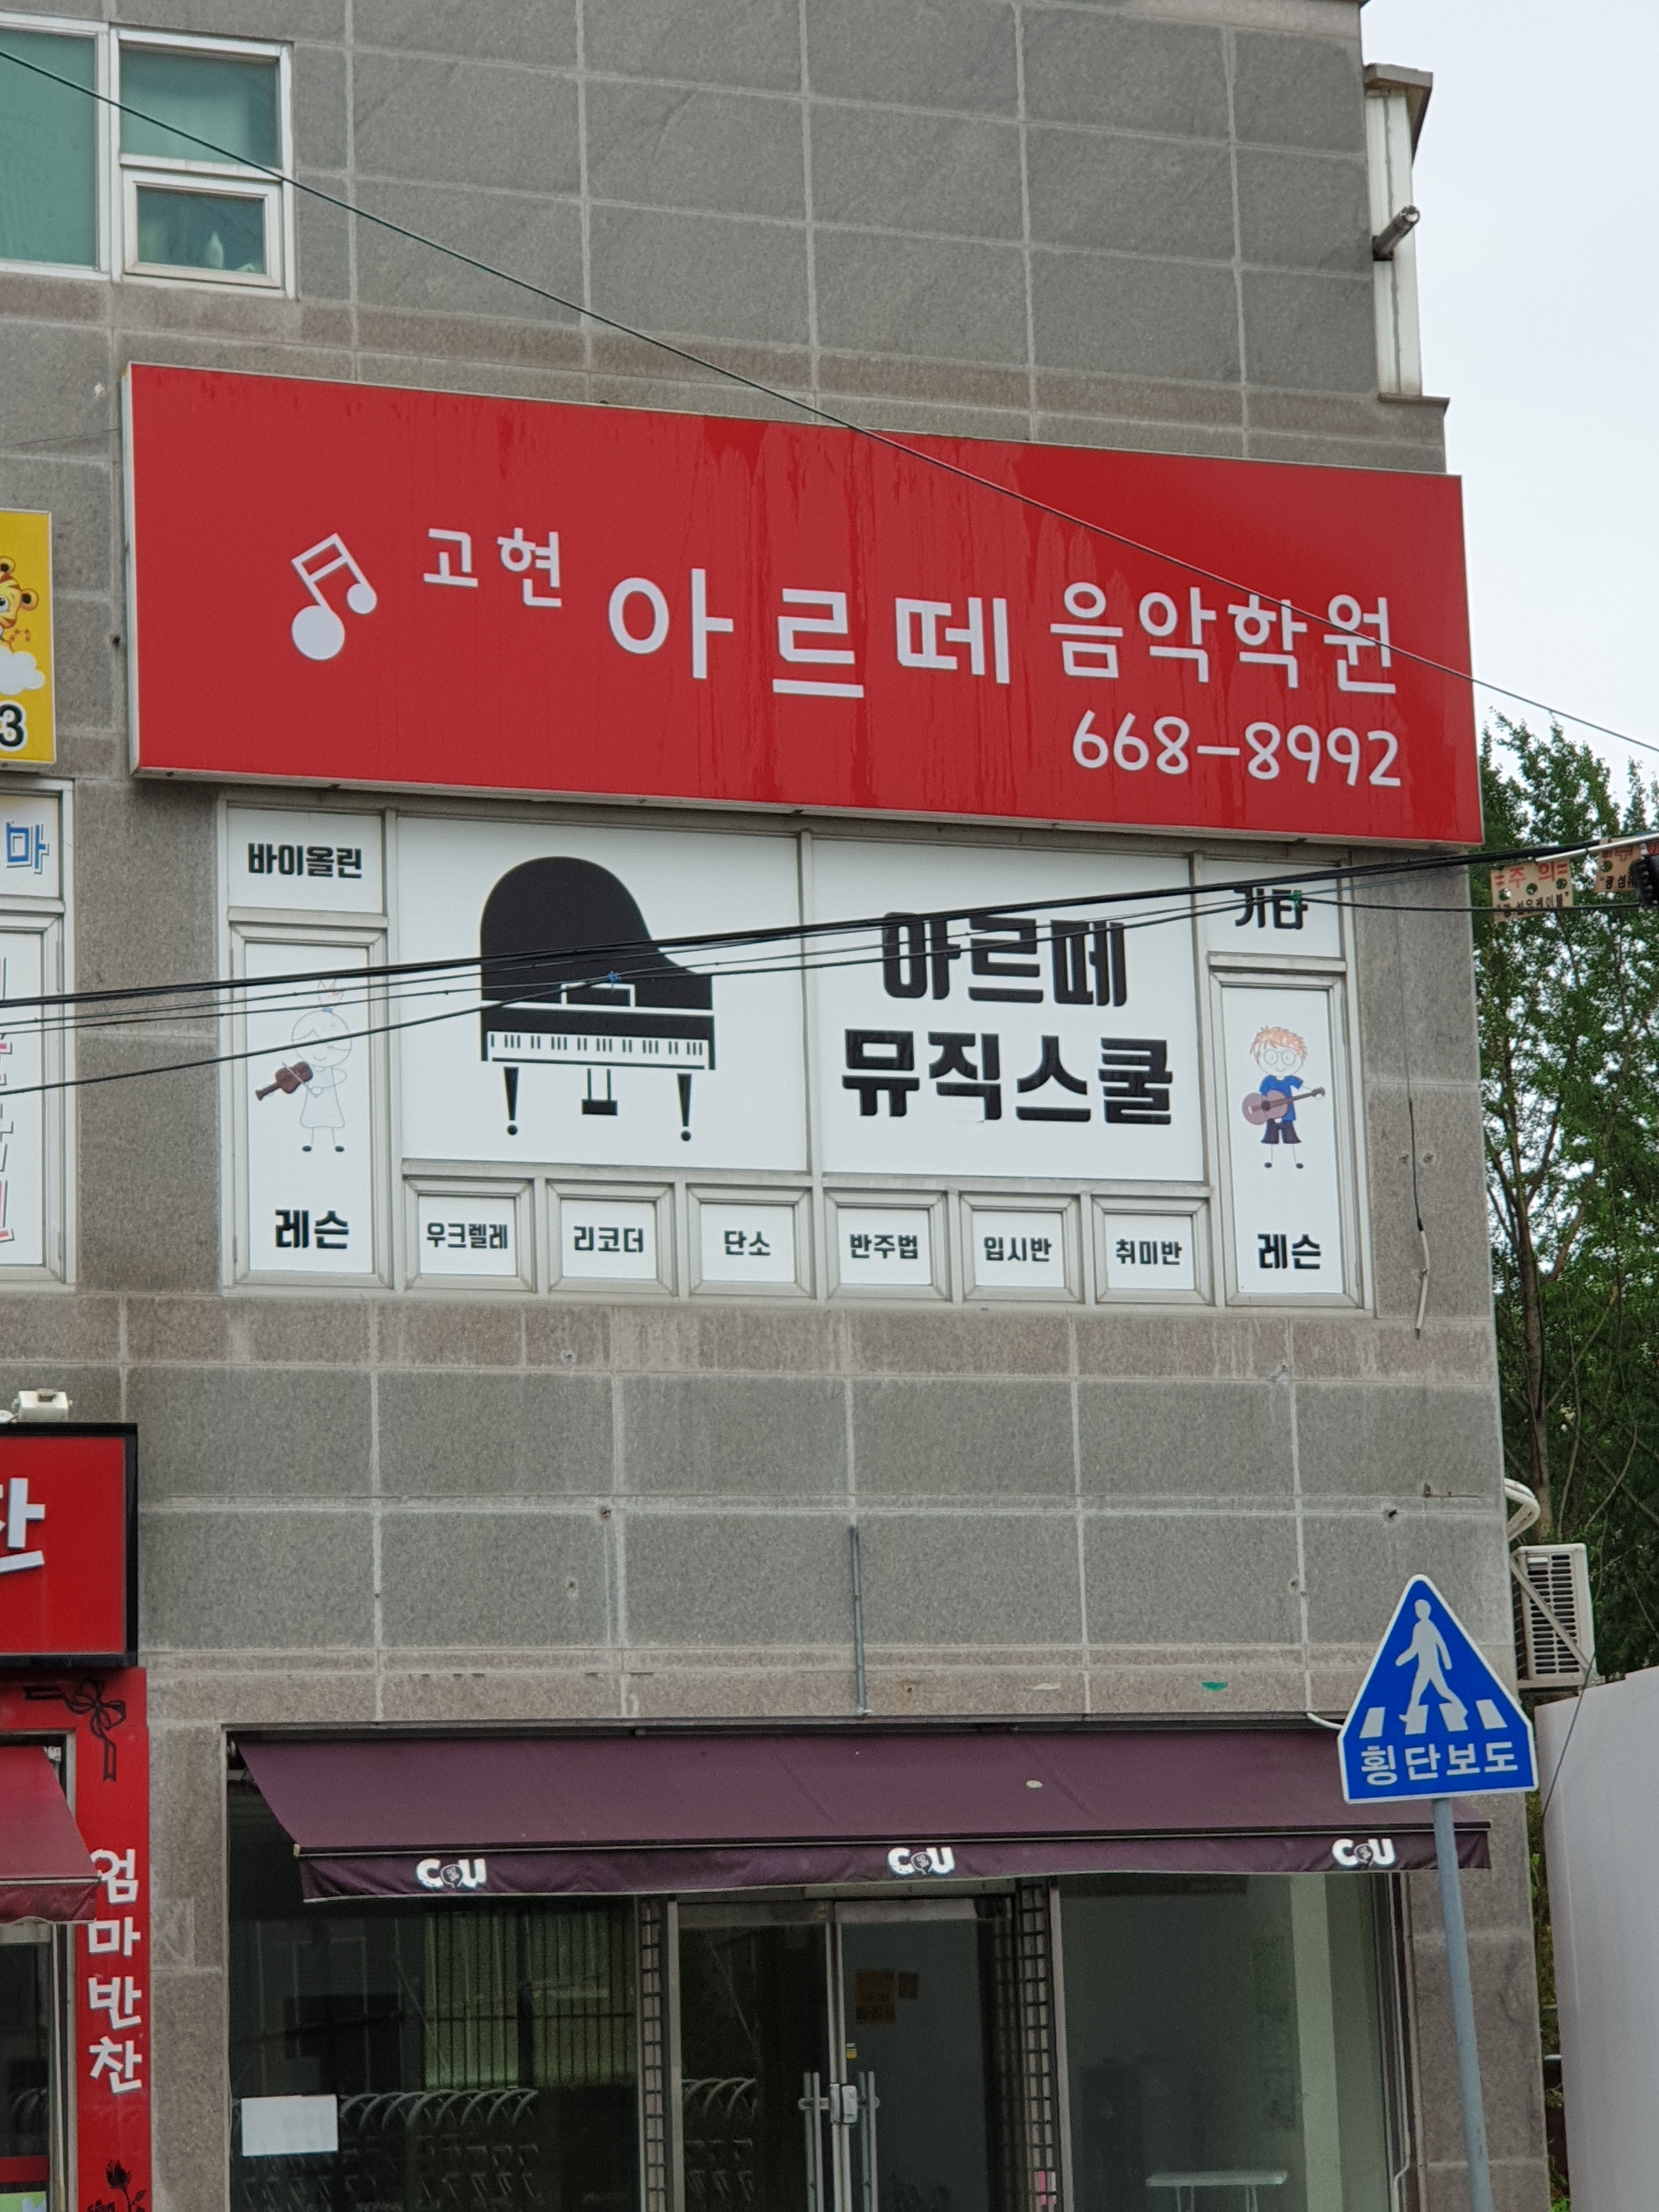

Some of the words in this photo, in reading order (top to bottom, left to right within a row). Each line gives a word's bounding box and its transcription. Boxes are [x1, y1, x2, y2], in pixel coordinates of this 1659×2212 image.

[424, 527, 561, 607] 고현
[608, 568, 1010, 698] 아르떼
[1050, 582, 1397, 694] 음악학원
[1073, 710, 1401, 787] 668-8992
[248, 843, 362, 879] 바이올린
[1233, 886, 1308, 930] 기타
[883, 912, 1127, 1007] 아르떼
[842, 1029, 1173, 1125] 뮤직스쿨
[275, 1210, 349, 1249] 레슨
[426, 1222, 508, 1249] 우크렐레
[574, 1226, 644, 1253] 리코더
[724, 1230, 771, 1256] 단소
[850, 1234, 918, 1260] 반주법
[984, 1237, 1052, 1262] 입시반
[1115, 1238, 1182, 1266] 취미반
[1257, 1234, 1322, 1269] 레슨
[1361, 1741, 1518, 1785] 횡단보도
[888, 1847, 955, 1875] CU
[1332, 1838, 1396, 1866] CU
[416, 1858, 486, 1888] CU
